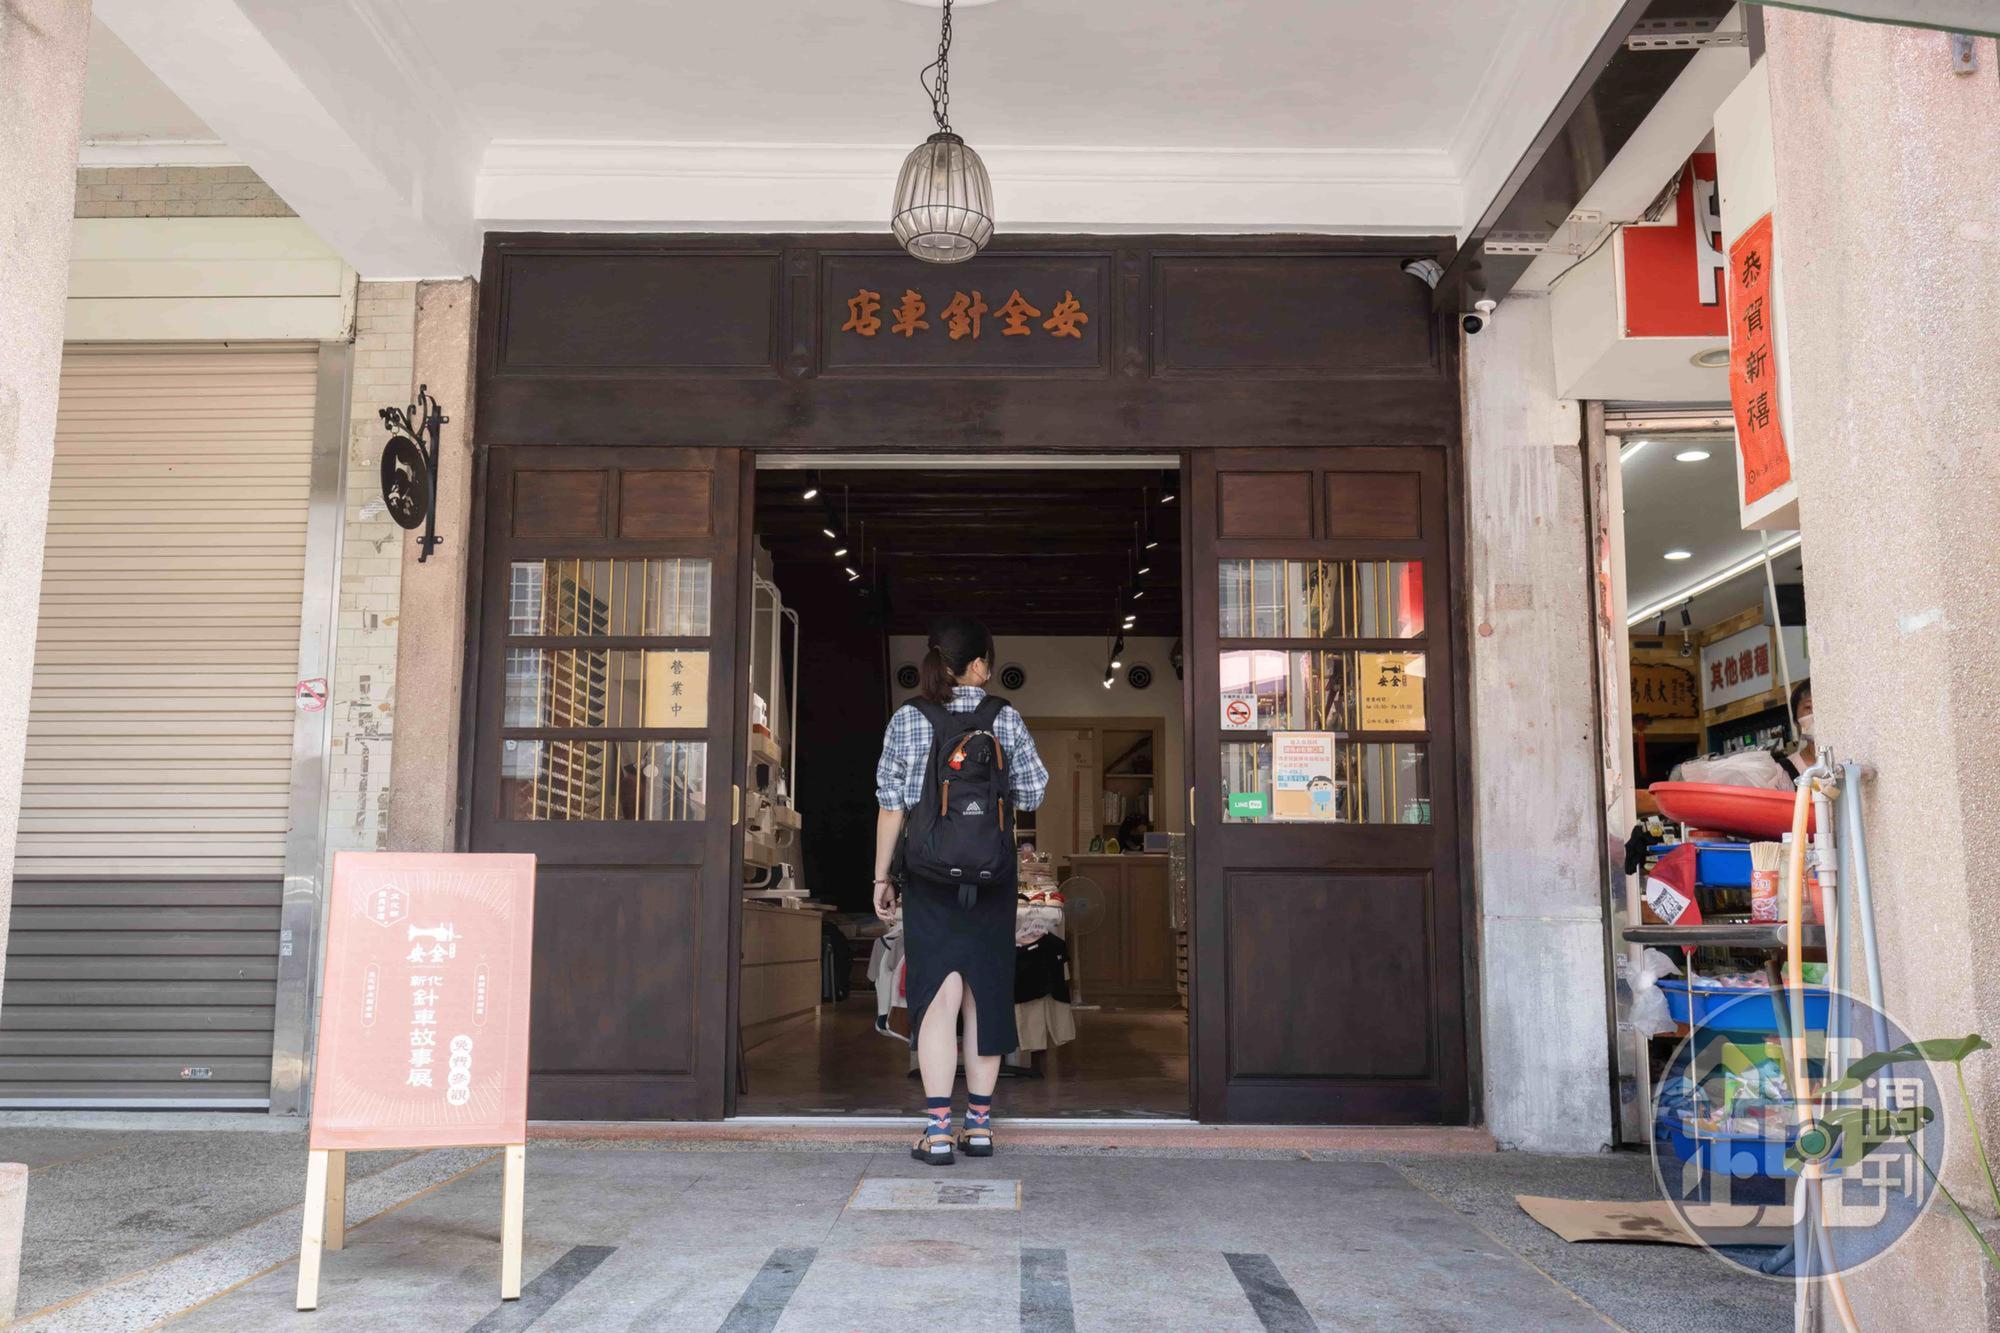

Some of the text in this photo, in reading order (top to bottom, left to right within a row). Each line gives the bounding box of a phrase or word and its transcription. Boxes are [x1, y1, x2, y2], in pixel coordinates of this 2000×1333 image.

[1742, 251, 1770, 433] 恭賀新禧
[671, 659, 684, 718] 營業中
[1710, 643, 1770, 692] 其他機種
[406, 943, 448, 963] 安全
[410, 975, 443, 987] 新化
[406, 989, 439, 1087] 針車故事展
